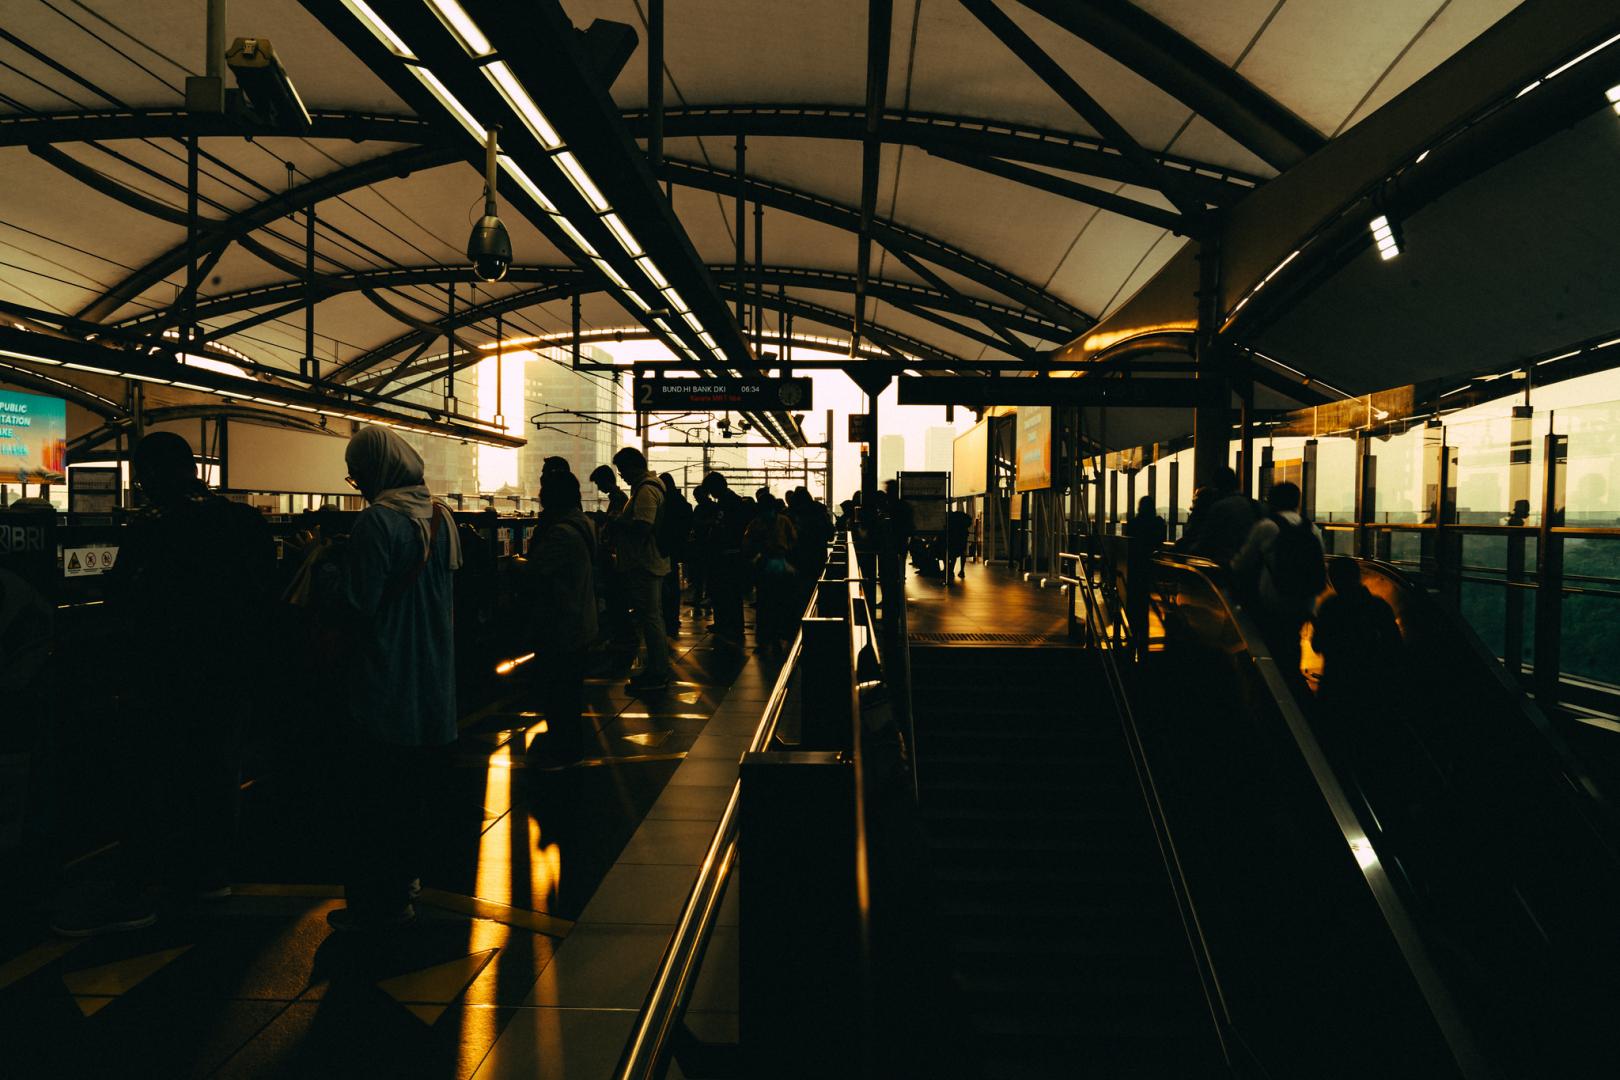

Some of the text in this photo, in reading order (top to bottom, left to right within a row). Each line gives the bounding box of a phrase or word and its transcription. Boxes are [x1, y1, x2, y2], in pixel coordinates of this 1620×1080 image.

[640, 384, 654, 404] 2
[692, 385, 712, 393] BANK
[713, 385, 726, 393] DKI
[741, 385, 760, 393] 06:34
[0, 402, 28, 414] PUBLIC
[12, 526, 45, 551] BRI
